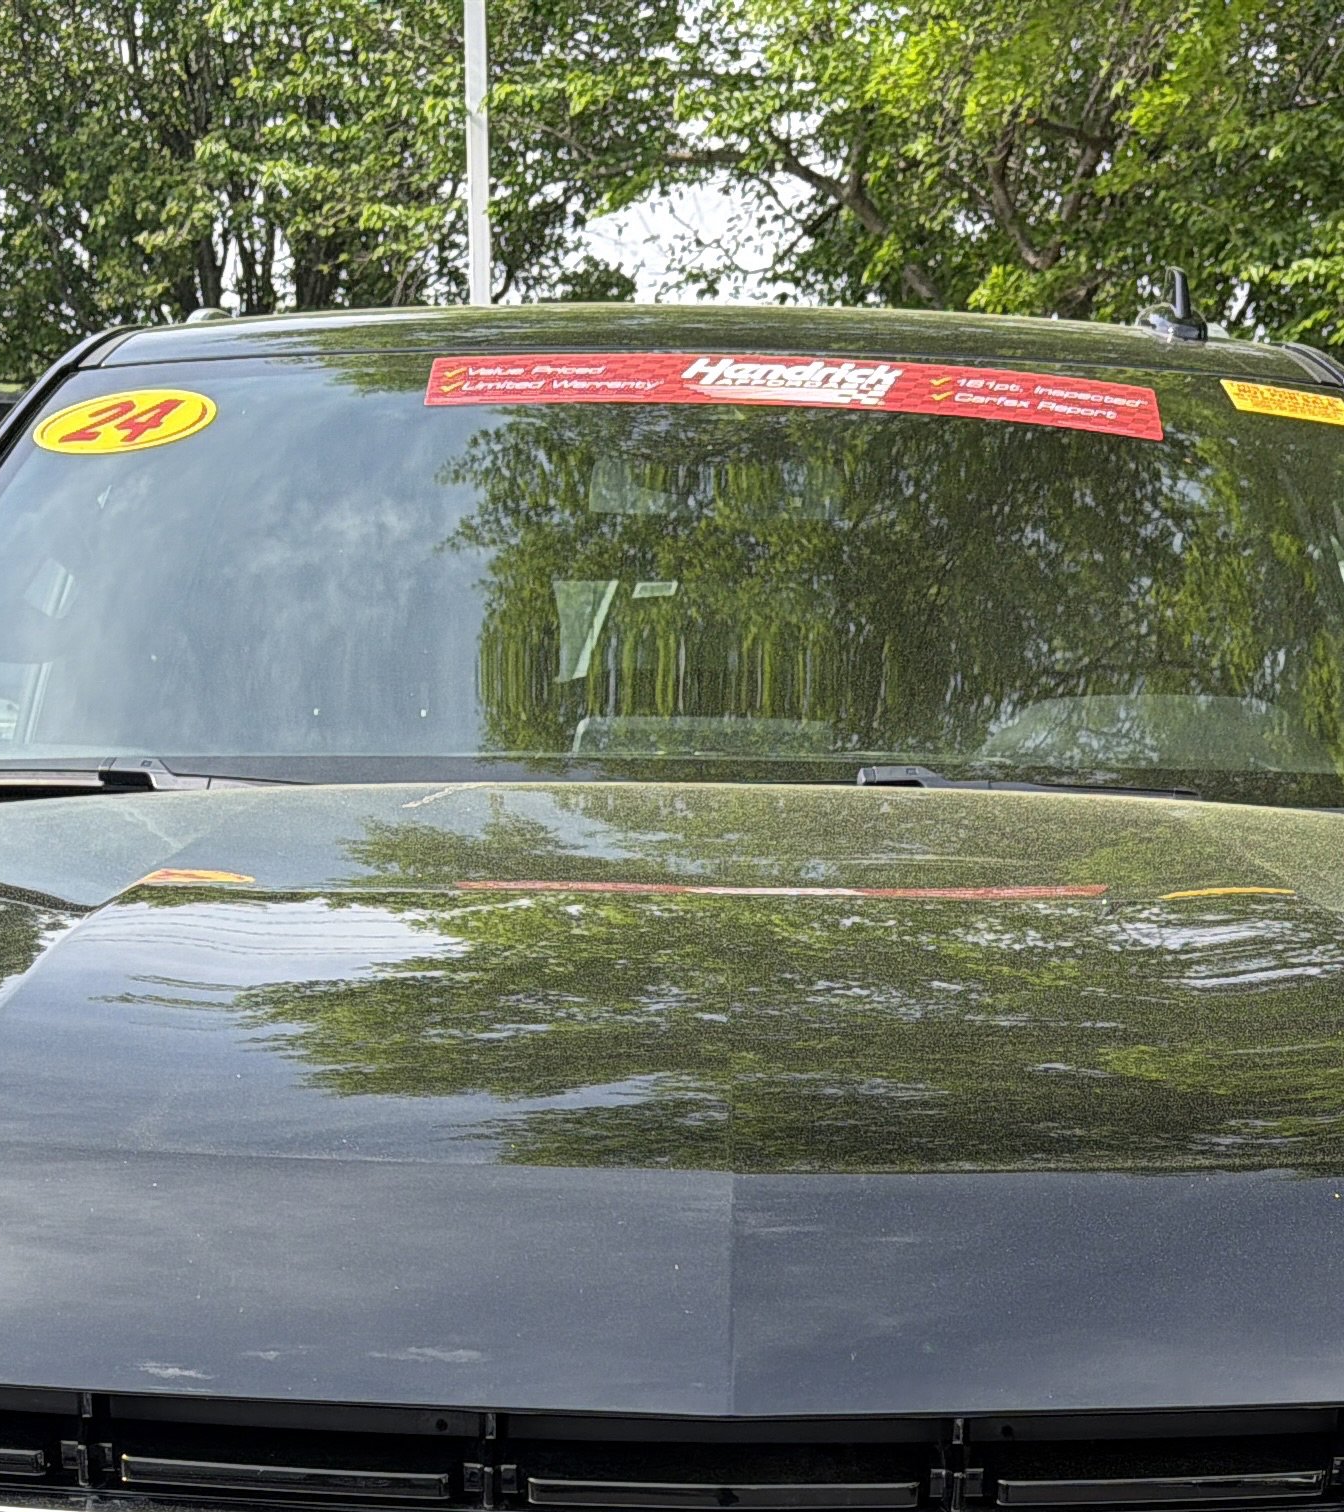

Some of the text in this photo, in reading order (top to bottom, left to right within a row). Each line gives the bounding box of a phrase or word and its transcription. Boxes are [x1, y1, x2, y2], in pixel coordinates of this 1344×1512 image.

[467, 365, 606, 376] Value Priced
[681, 357, 904, 388] Hendrick
[462, 379, 545, 391] Limited
[954, 393, 1119, 420] Carfax Report
[58, 398, 186, 444] 24
